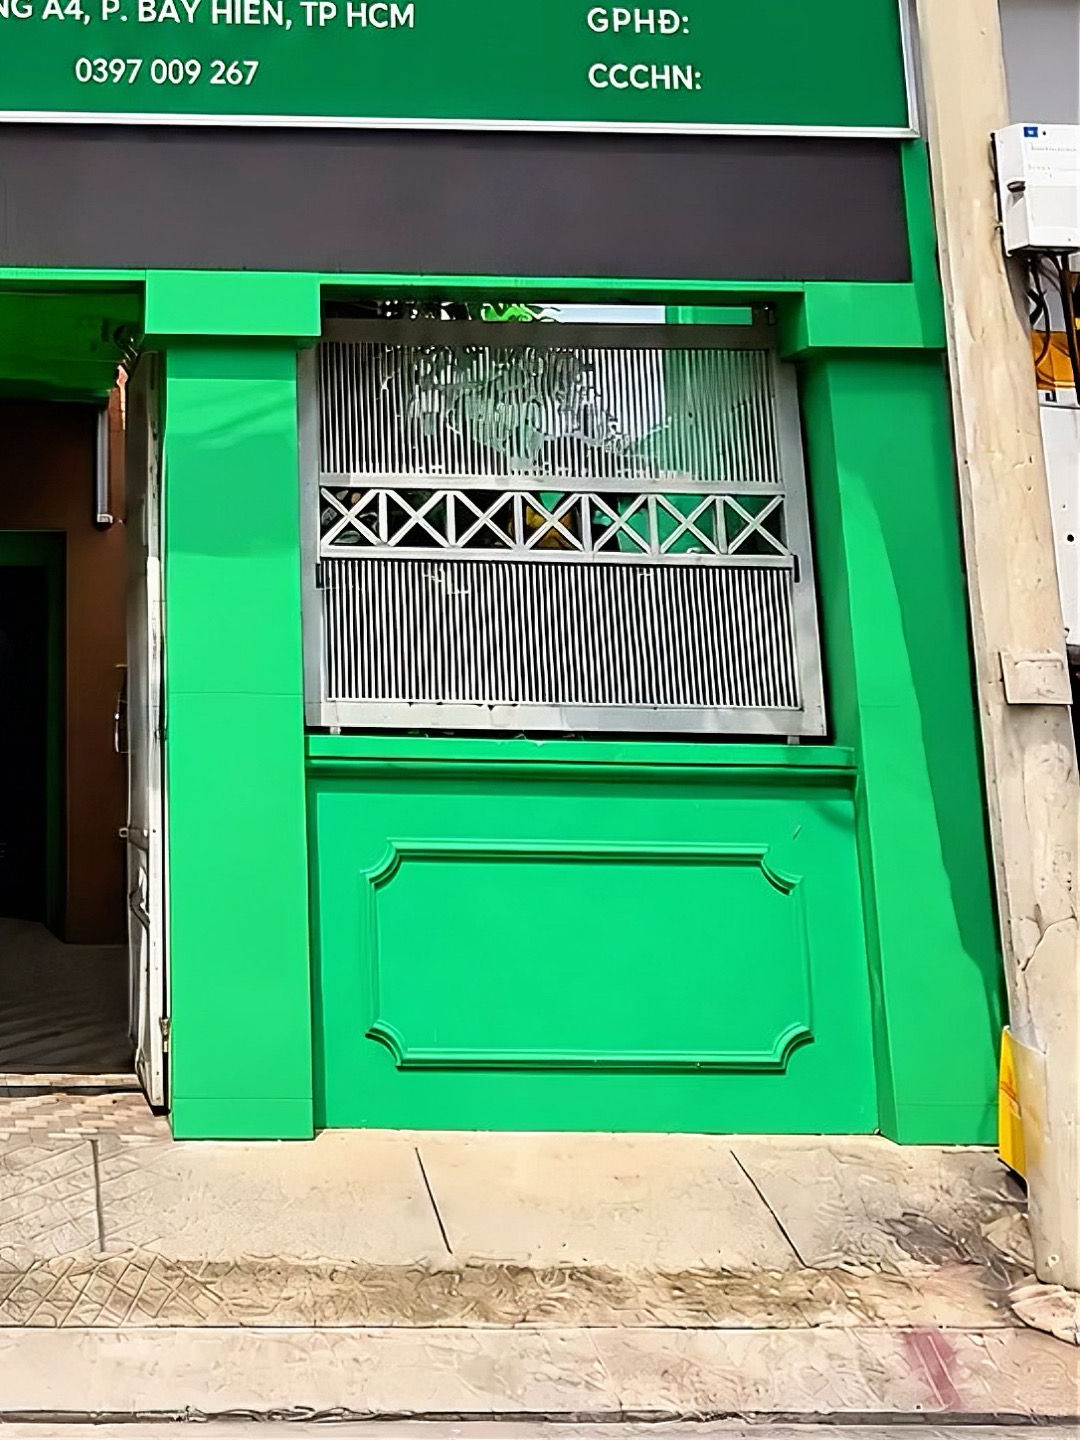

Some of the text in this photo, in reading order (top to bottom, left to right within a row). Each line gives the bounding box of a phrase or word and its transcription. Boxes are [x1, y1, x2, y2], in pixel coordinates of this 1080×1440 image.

[300, 1, 337, 27] TP
[346, 2, 414, 29] HCM
[587, 8, 689, 34] GPHĐ:
[75, 57, 143, 84] 0397
[150, 59, 202, 85] 009
[209, 60, 259, 85] 267
[588, 64, 702, 90] CCCHN:
